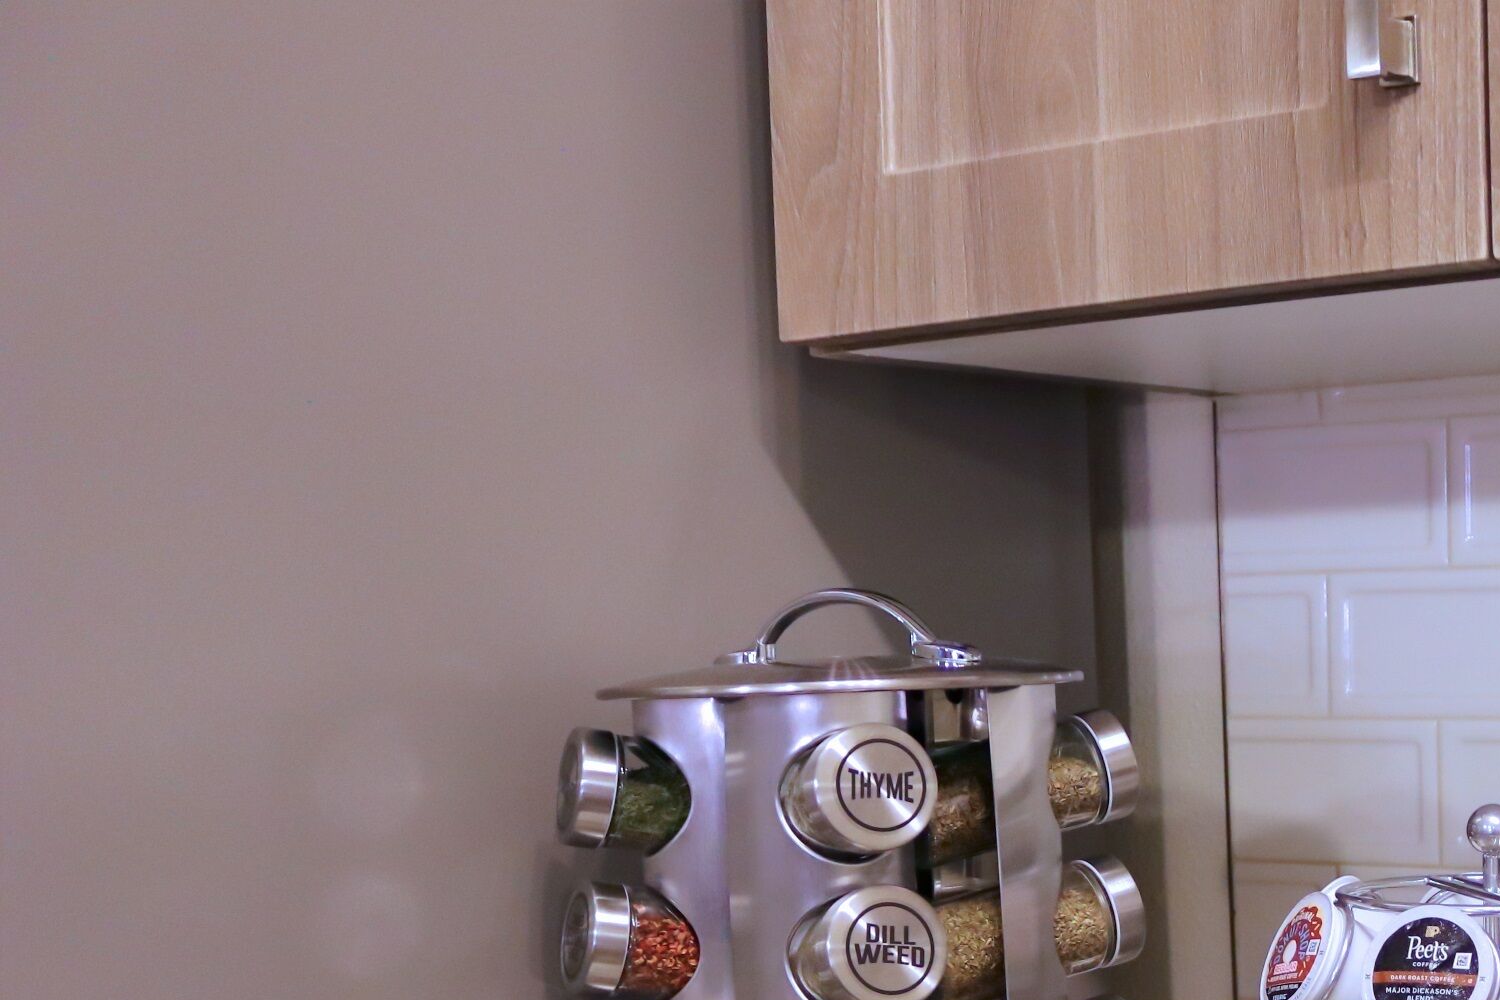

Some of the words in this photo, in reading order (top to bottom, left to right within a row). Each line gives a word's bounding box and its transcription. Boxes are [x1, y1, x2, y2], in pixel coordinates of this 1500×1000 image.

[848, 768, 915, 804] THYME
[865, 923, 917, 945] DILL
[854, 943, 925, 968] WEED
[1412, 987, 1458, 996] DICKASON'S
